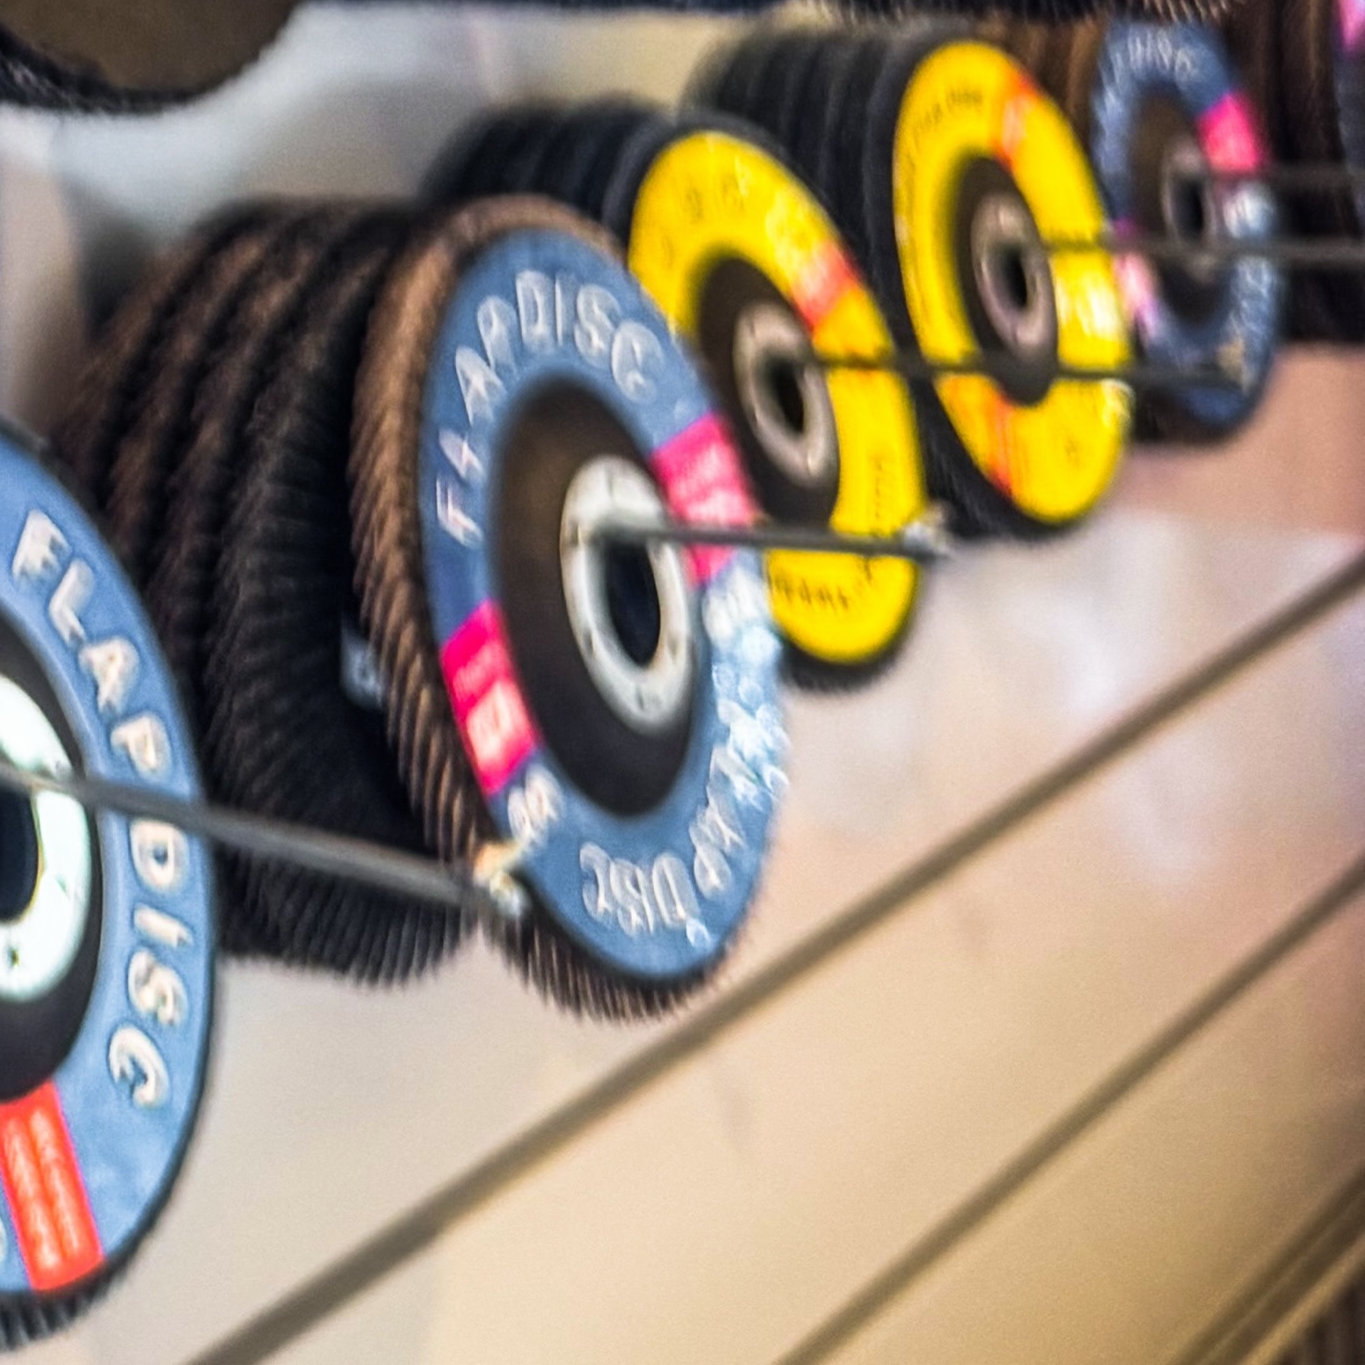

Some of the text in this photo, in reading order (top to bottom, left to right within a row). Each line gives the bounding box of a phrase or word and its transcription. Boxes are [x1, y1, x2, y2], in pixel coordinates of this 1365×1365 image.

[515, 269, 667, 405] DISC
[11, 508, 190, 1108] FLAP DISC
